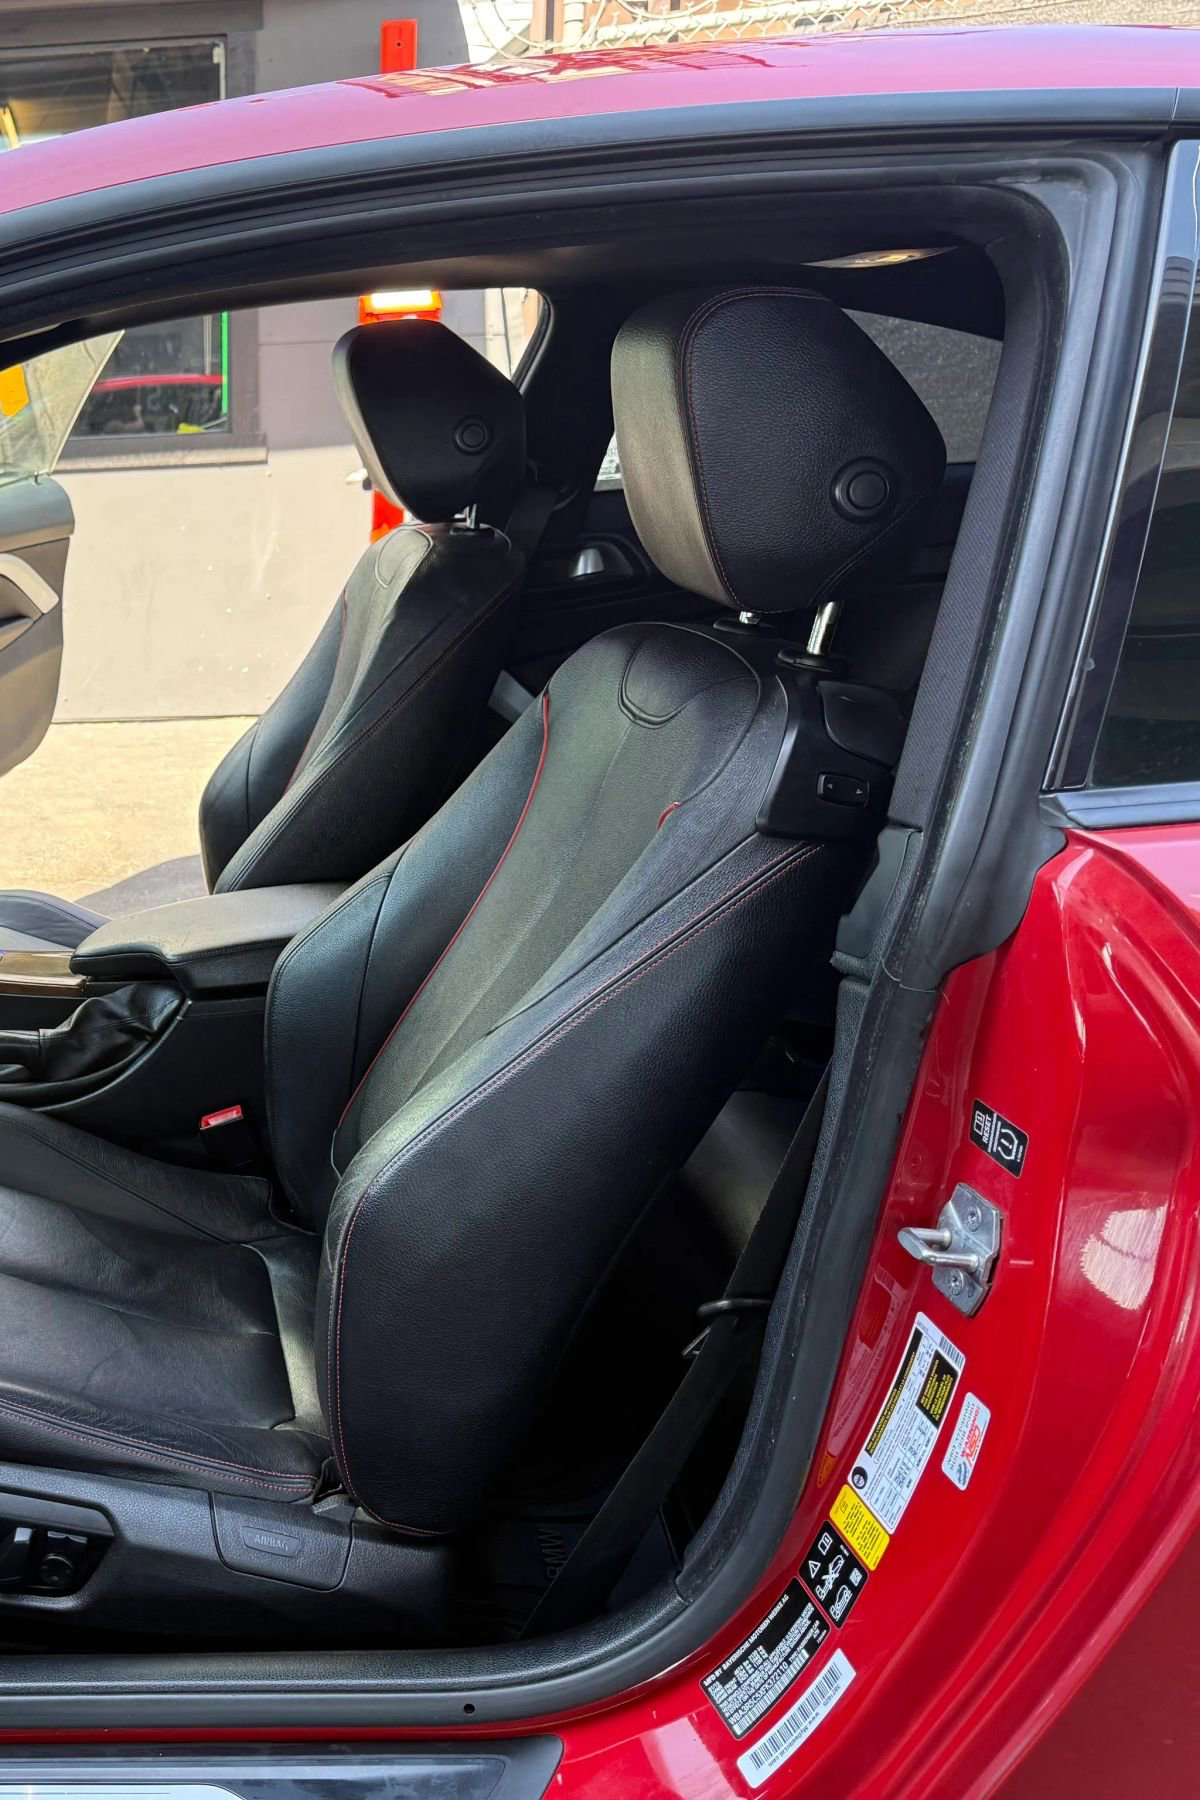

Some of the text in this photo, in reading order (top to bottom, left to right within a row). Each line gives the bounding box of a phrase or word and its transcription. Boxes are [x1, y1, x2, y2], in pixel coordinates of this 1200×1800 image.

[982, 1113, 991, 1143] RESET
[254, 1534, 289, 1551] AIRBAG
[721, 1640, 750, 1670] BAYERISCHE
[748, 1617, 770, 1643] MOTOREN
[767, 1600, 783, 1620] WERKE
[781, 1593, 788, 1604] AG
